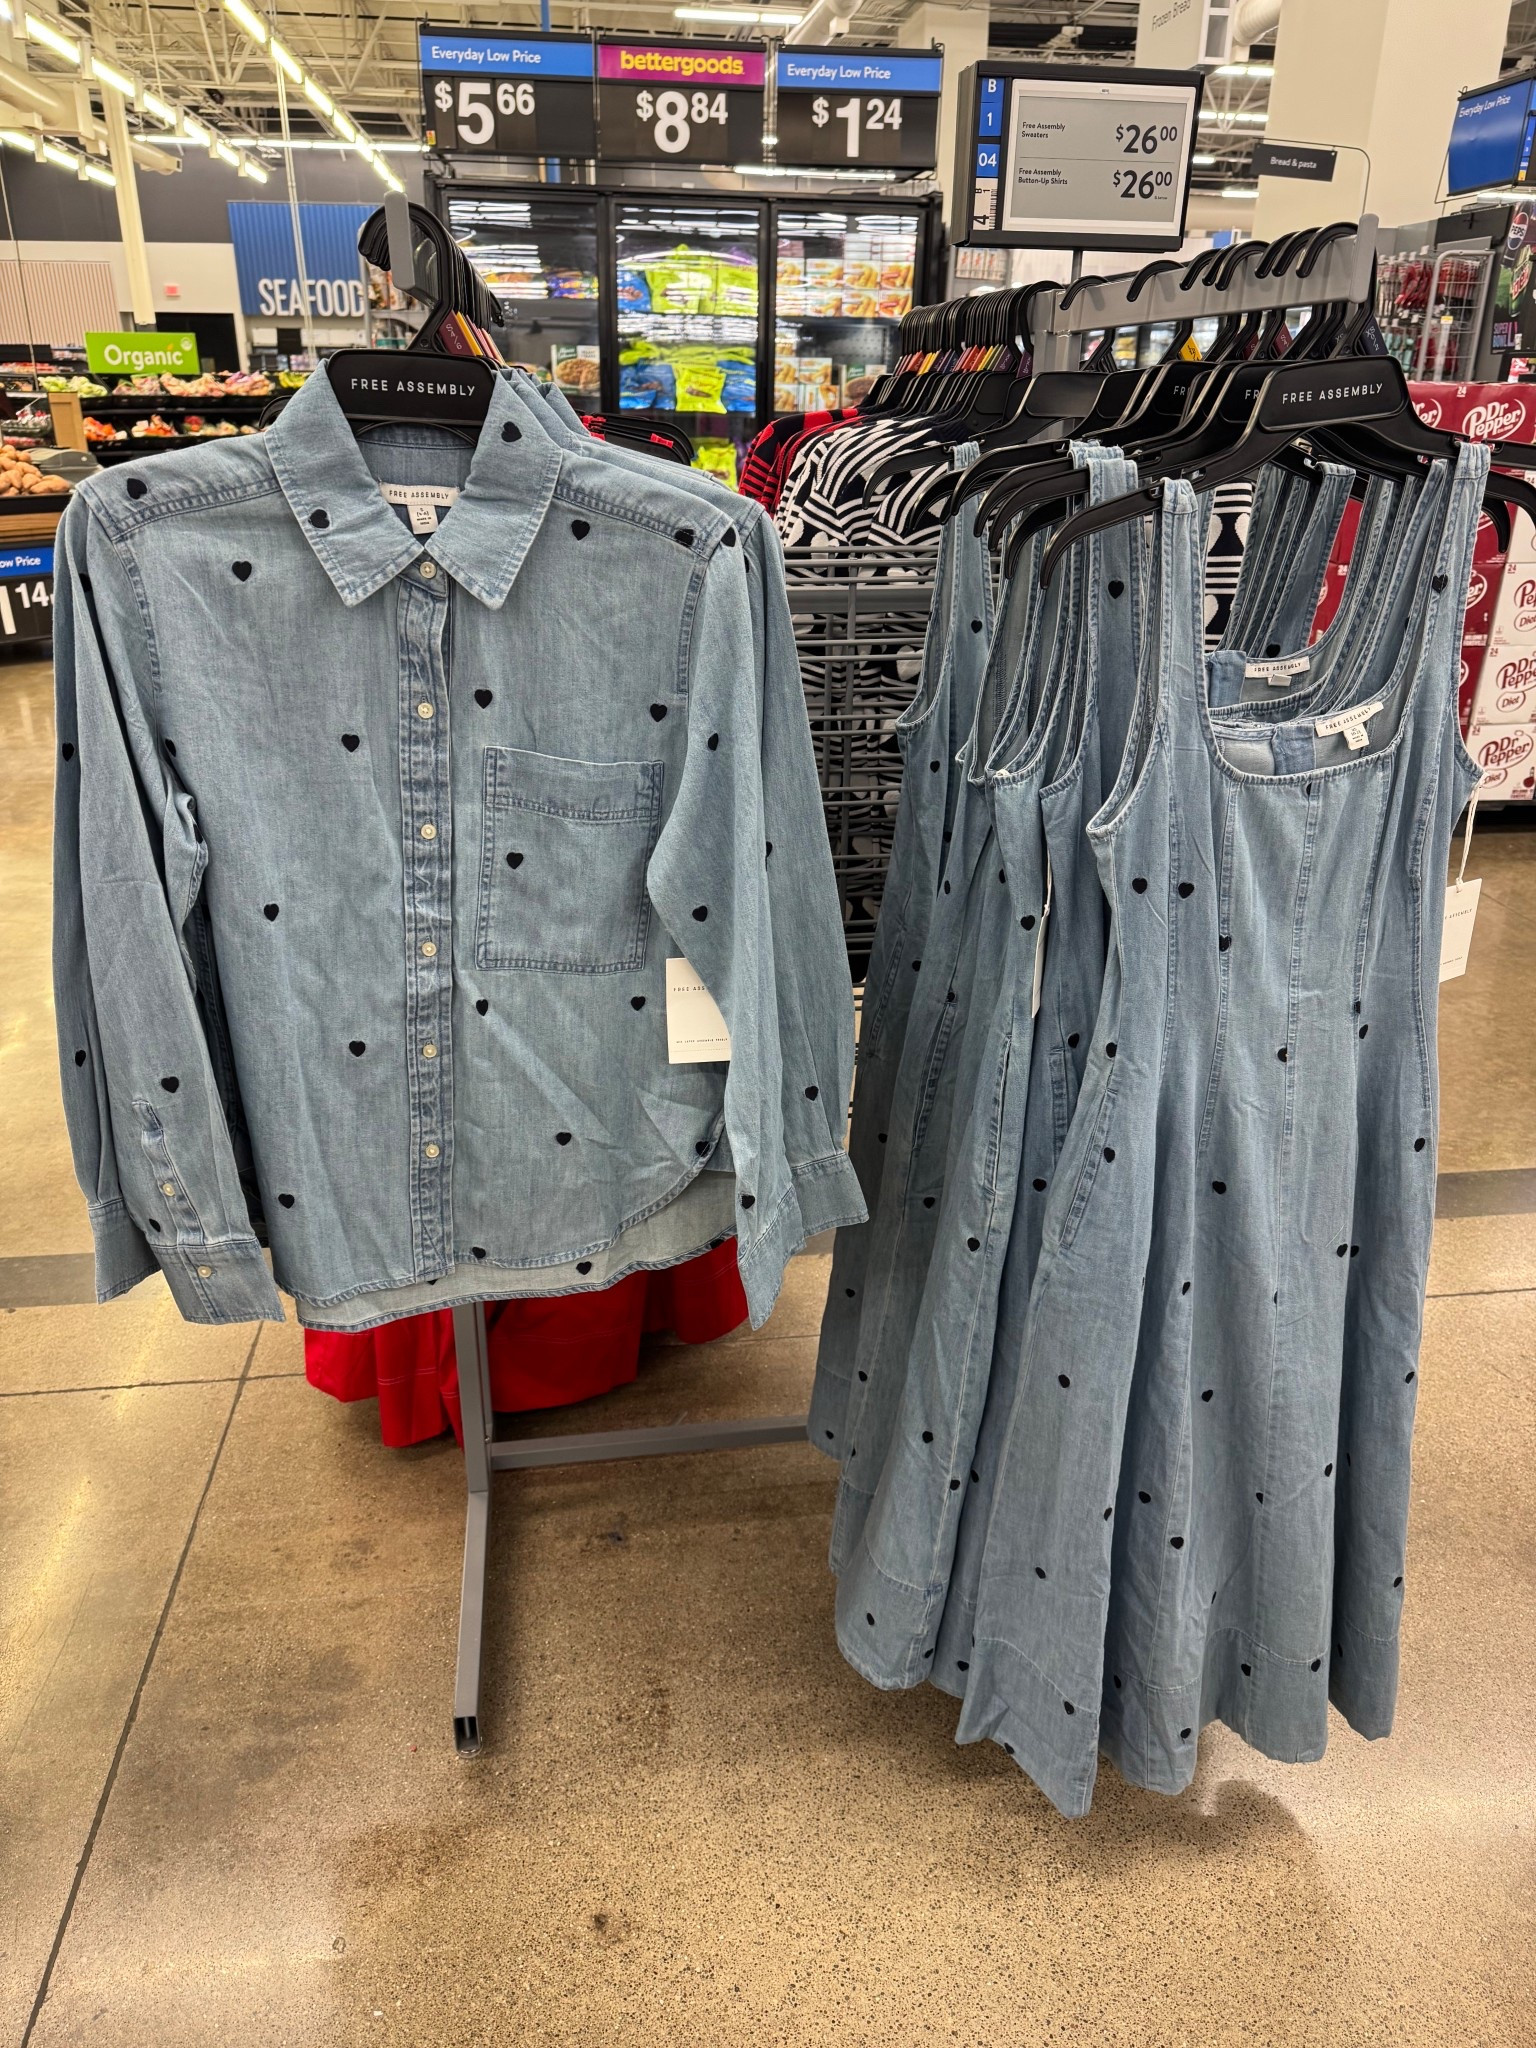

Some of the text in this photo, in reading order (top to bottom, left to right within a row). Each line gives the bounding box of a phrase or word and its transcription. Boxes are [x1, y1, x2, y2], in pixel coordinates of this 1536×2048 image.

[431, 46, 542, 64] Everyday Low Price
[620, 50, 744, 76] bettergoods
[787, 63, 892, 80] Everyday Low Price
[987, 78, 997, 93] B
[1458, 95, 1511, 118] Everyday Low Price
[986, 111, 993, 127] 1
[1022, 121, 1066, 132] Free Assembly
[1021, 131, 1049, 139] Sweaters
[978, 153, 997, 167] 04
[1270, 156, 1317, 170] Bread & pasta
[1018, 177, 1068, 186] Button-Up Shirts
[1032, 168, 1062, 178] Assembly
[258, 278, 366, 317] SEAFOOD
[103, 344, 183, 371] Organic
[351, 378, 475, 396] FREE ASSEMBLY
[1282, 383, 1383, 405] FREE ASSEMBLY
[1487, 402, 1509, 423] Dr
[1469, 406, 1521, 439] Pepper
[389, 489, 449, 500] FREE ASSEMBLY
[0, 556, 42, 569] ow Price
[1501, 663, 1536, 689] Peppe
[1500, 736, 1519, 751] Dr
[1483, 741, 1531, 768] Pepper
